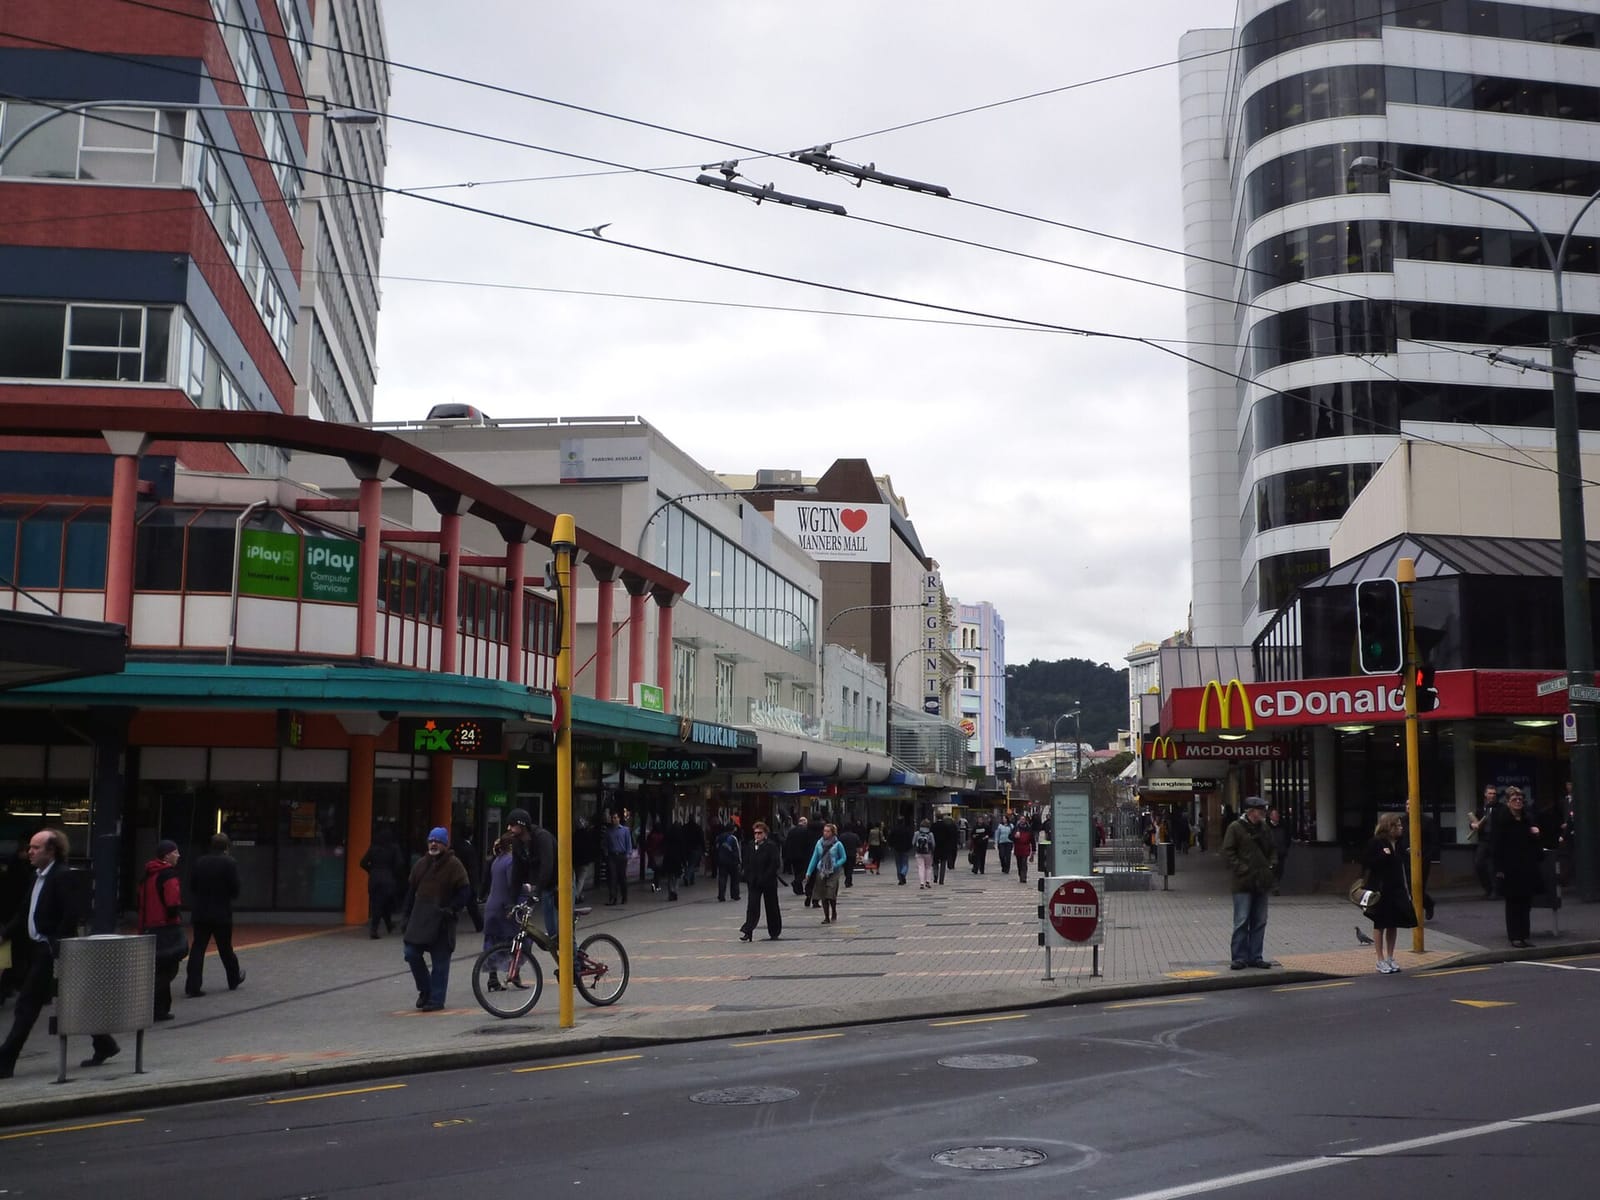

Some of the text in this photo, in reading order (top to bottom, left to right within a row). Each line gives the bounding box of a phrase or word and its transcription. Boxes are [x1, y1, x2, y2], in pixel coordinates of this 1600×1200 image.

[798, 506, 840, 533] WGTN
[798, 534, 868, 551] MANNERS MALL
[247, 545, 281, 564] iPlay
[308, 546, 355, 573] iPlay
[310, 571, 351, 583] Computer
[313, 582, 348, 593] Services
[927, 576, 937, 691] REGENT
[460, 729, 475, 740] 24
[692, 722, 738, 749] HURRICANE
[1185, 744, 1282, 757] McDonald's
[1061, 905, 1092, 916] NO ENTRY
